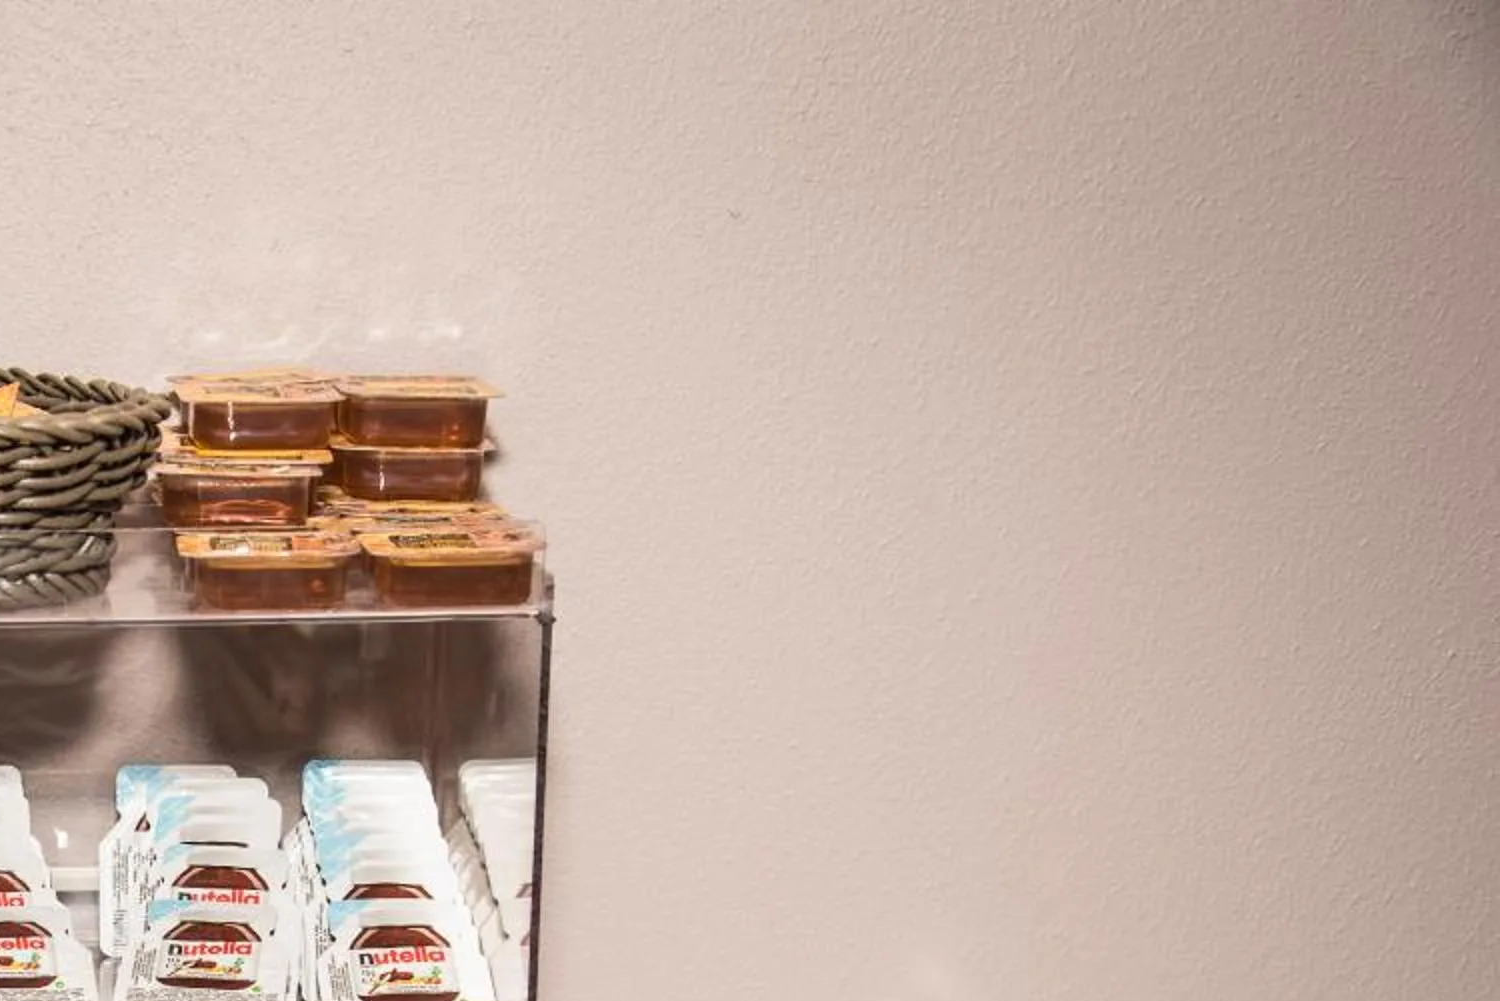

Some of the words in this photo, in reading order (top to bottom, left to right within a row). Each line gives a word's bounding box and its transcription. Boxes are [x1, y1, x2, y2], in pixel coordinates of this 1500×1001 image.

[177, 888, 260, 905] nutella
[168, 940, 253, 956] nutella
[359, 943, 446, 965] nutella
